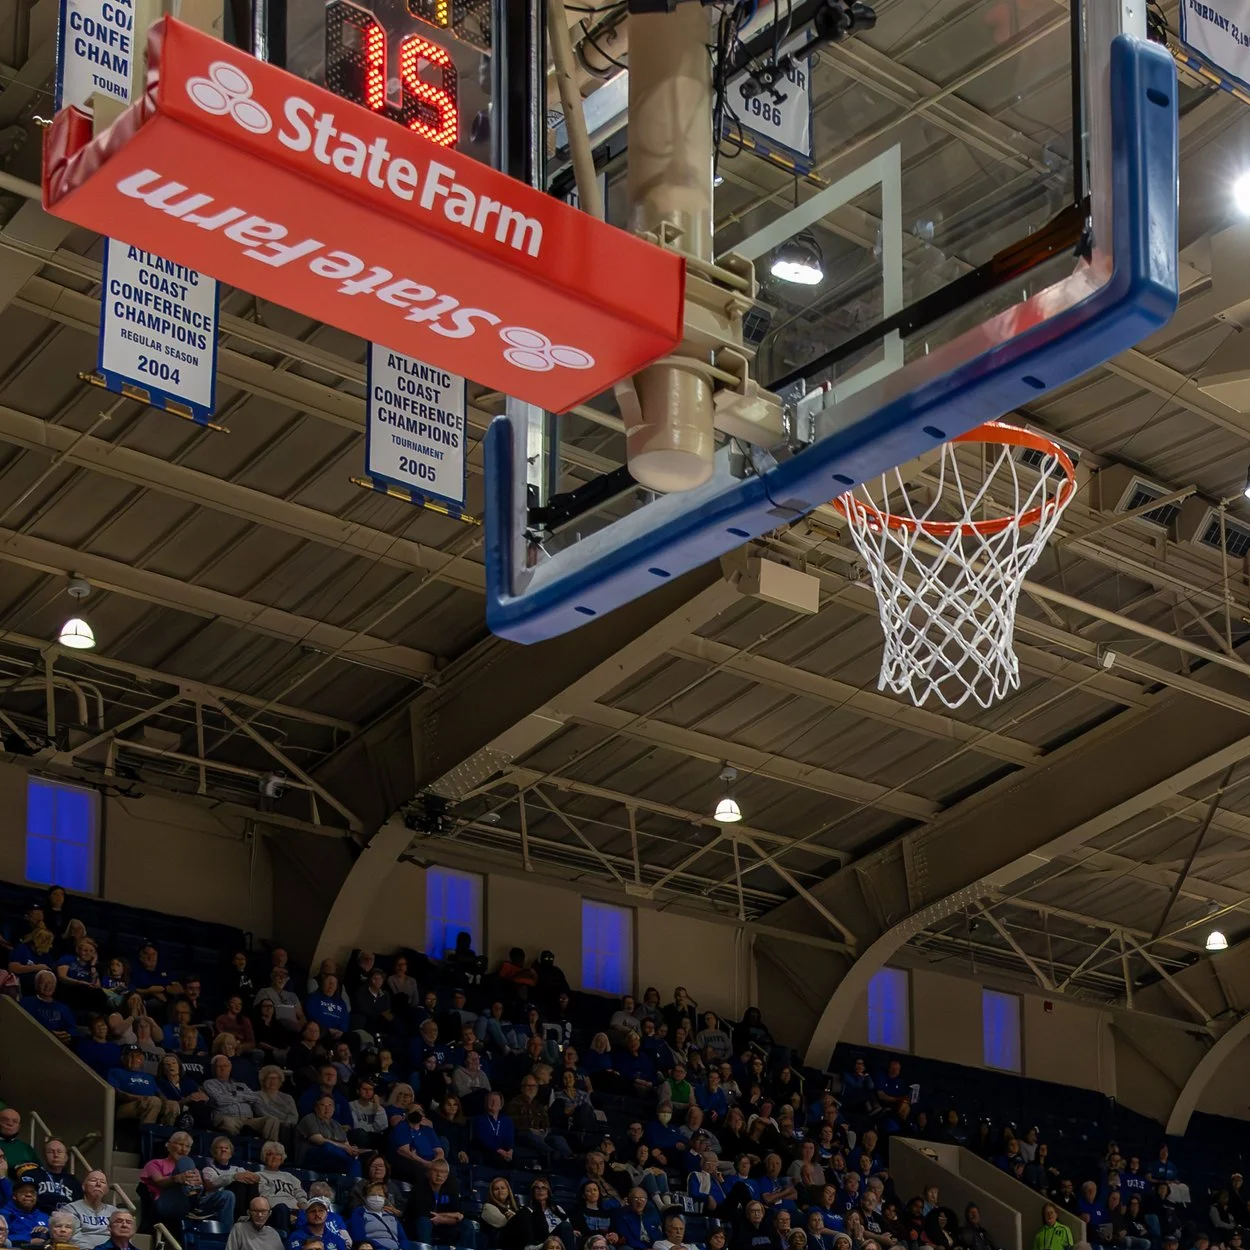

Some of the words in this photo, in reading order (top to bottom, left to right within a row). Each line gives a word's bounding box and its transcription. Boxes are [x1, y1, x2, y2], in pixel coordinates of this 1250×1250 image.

[367, 25, 457, 147] 15
[277, 96, 545, 258] StateFarm
[116, 168, 501, 339] StateFarm
[127, 245, 199, 287] ATLANTIC
[110, 279, 212, 333] CONFERENCE
[138, 269, 188, 301] COAST
[114, 301, 207, 351] CHAMPIONS
[121, 328, 162, 352] REGULAR
[164, 345, 199, 367] SEASON
[137, 354, 181, 385] 2004
[387, 353, 451, 388] ATLANTIC
[397, 376, 440, 404] COAST
[374, 386, 463, 431] CONFERENCE
[378, 406, 459, 448] CHAMPIONS
[391, 434, 444, 461] TOURNAMENT
[399, 456, 436, 482] 2005
